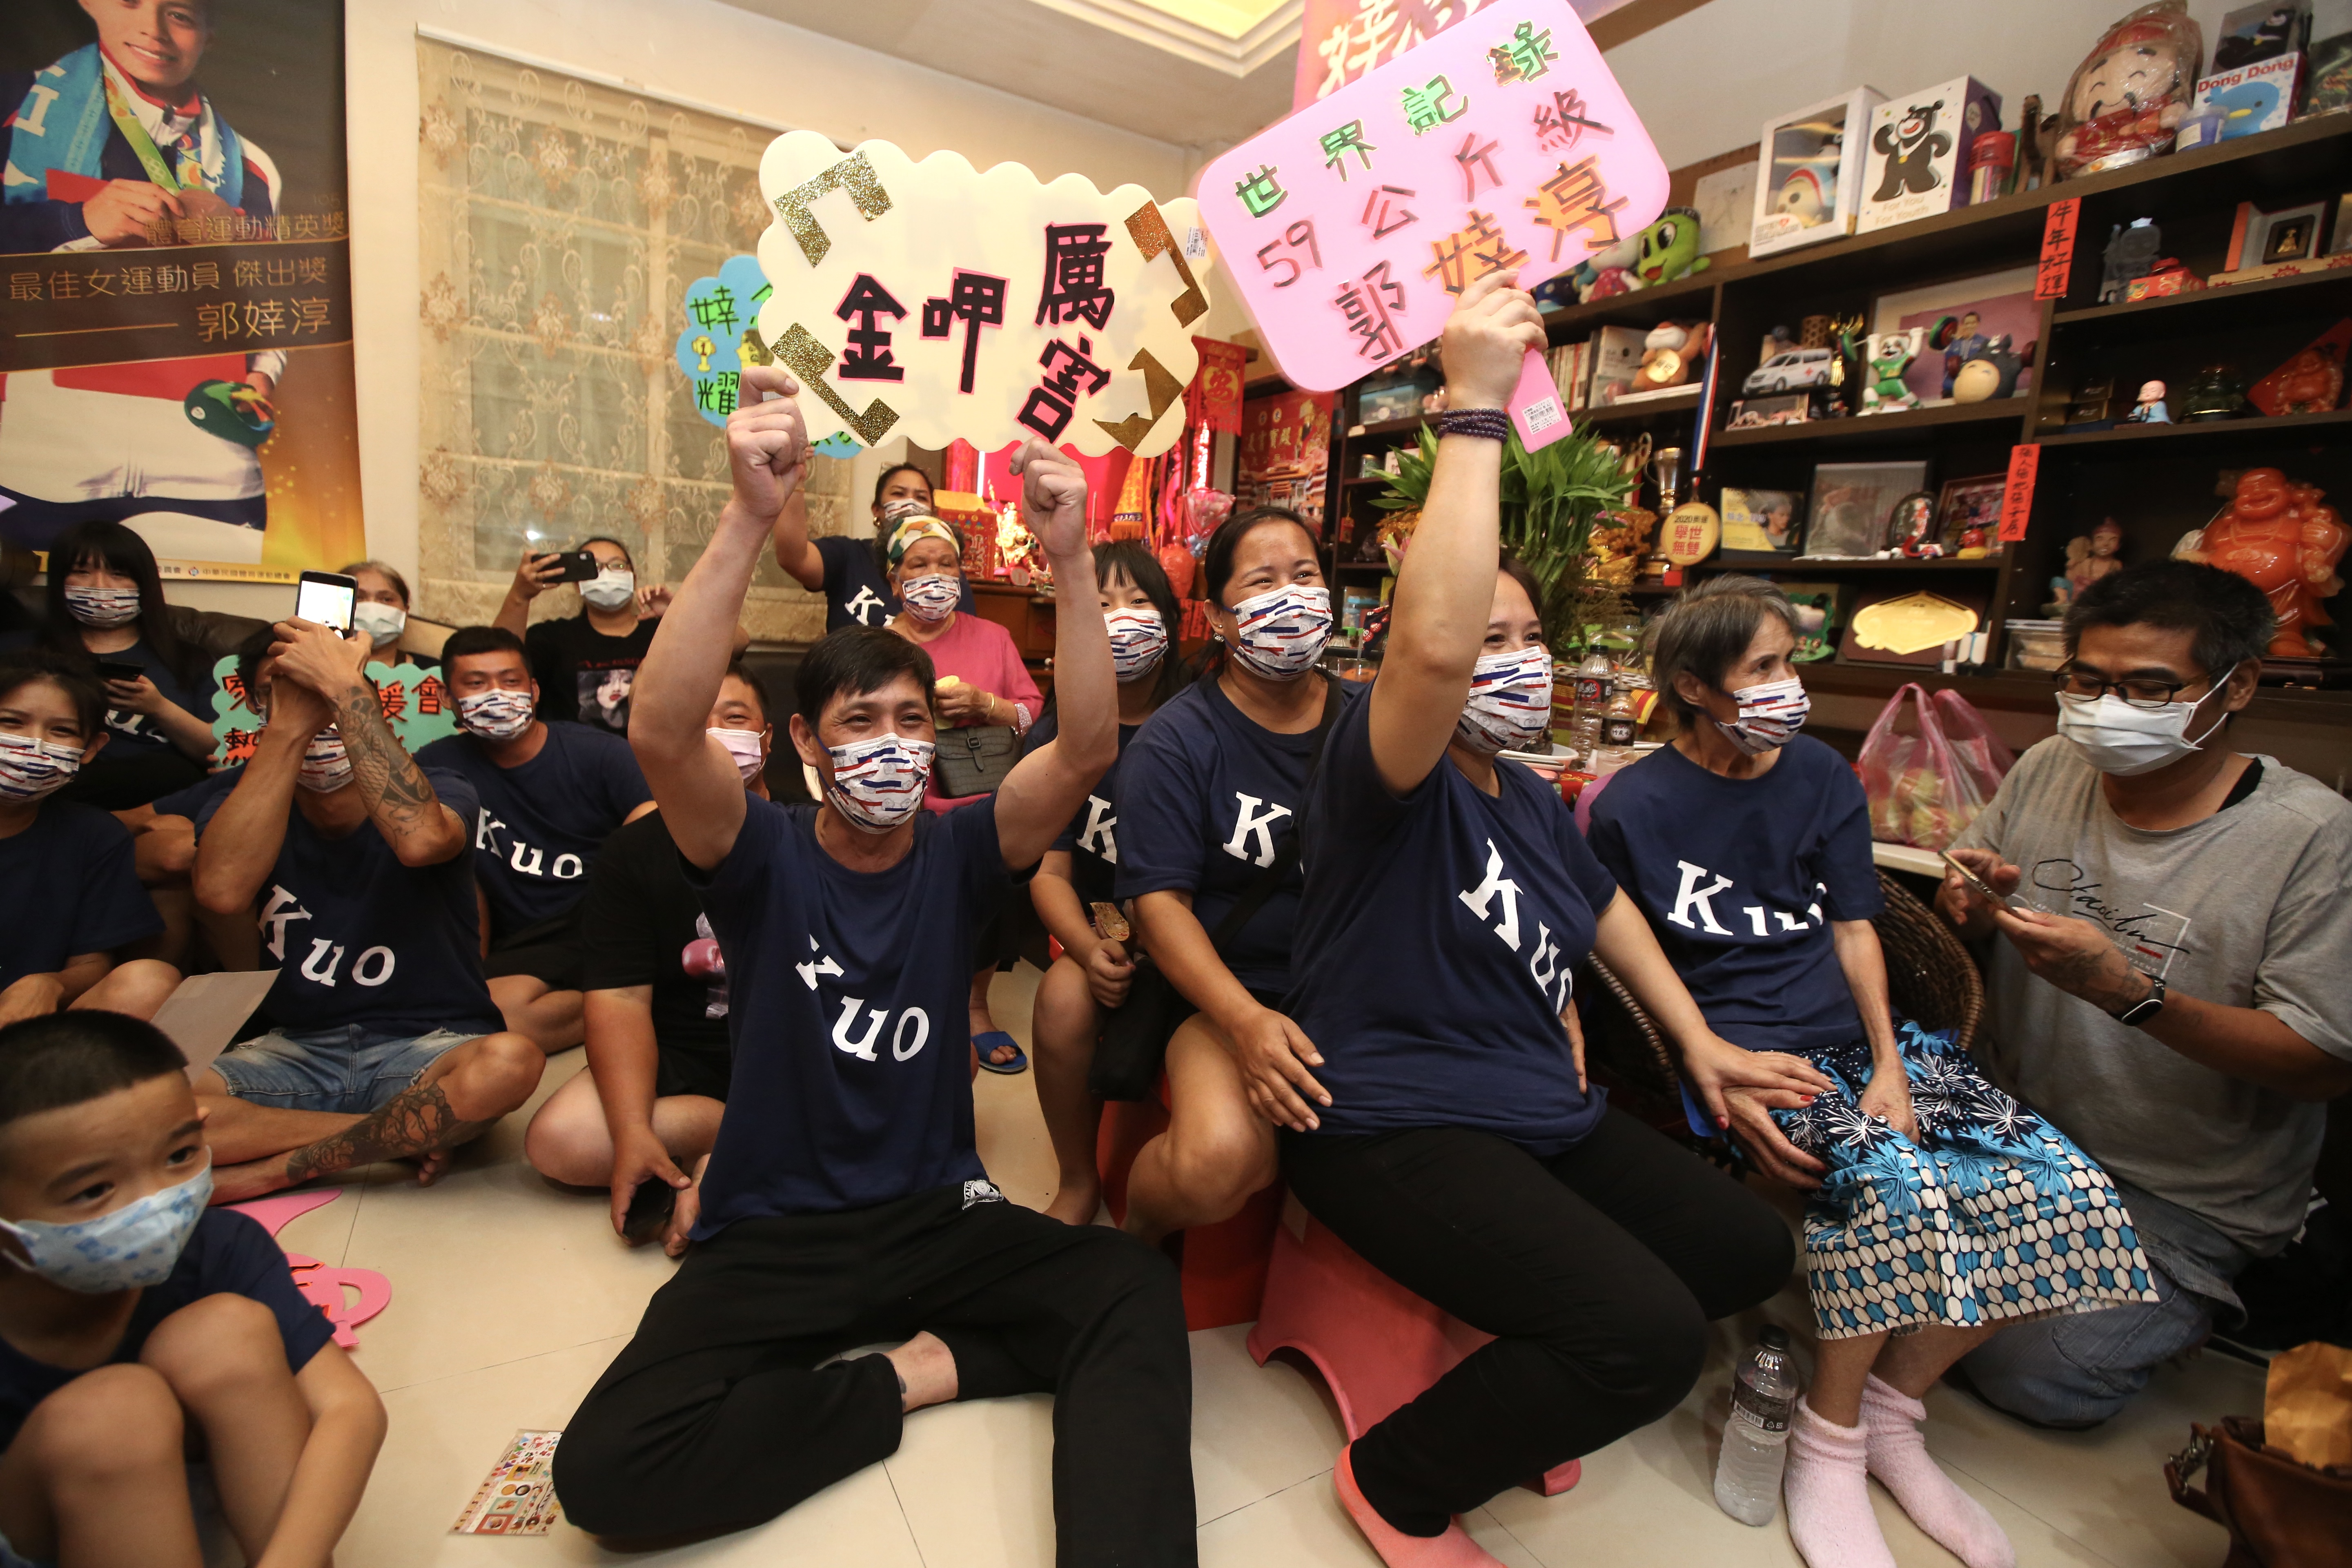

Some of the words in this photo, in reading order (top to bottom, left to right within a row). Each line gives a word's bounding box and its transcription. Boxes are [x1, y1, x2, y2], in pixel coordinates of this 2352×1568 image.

[2198, 74, 2242, 92] Dong
[2247, 59, 2294, 78] Dong
[1235, 19, 1560, 218] 世界記錄
[1897, 205, 1929, 221] Youth
[1904, 196, 1924, 206] You
[1329, 154, 1629, 361] 郭婞淳
[2039, 201, 2072, 296] 牛年好運
[10, 261, 220, 301] 最佳女運動員
[233, 256, 327, 288] 傑出獎
[196, 296, 331, 343] 郭婞淳
[697, 370, 741, 415] 光耀
[1672, 541, 1700, 556] 無雙
[259, 884, 395, 987] Kuo
